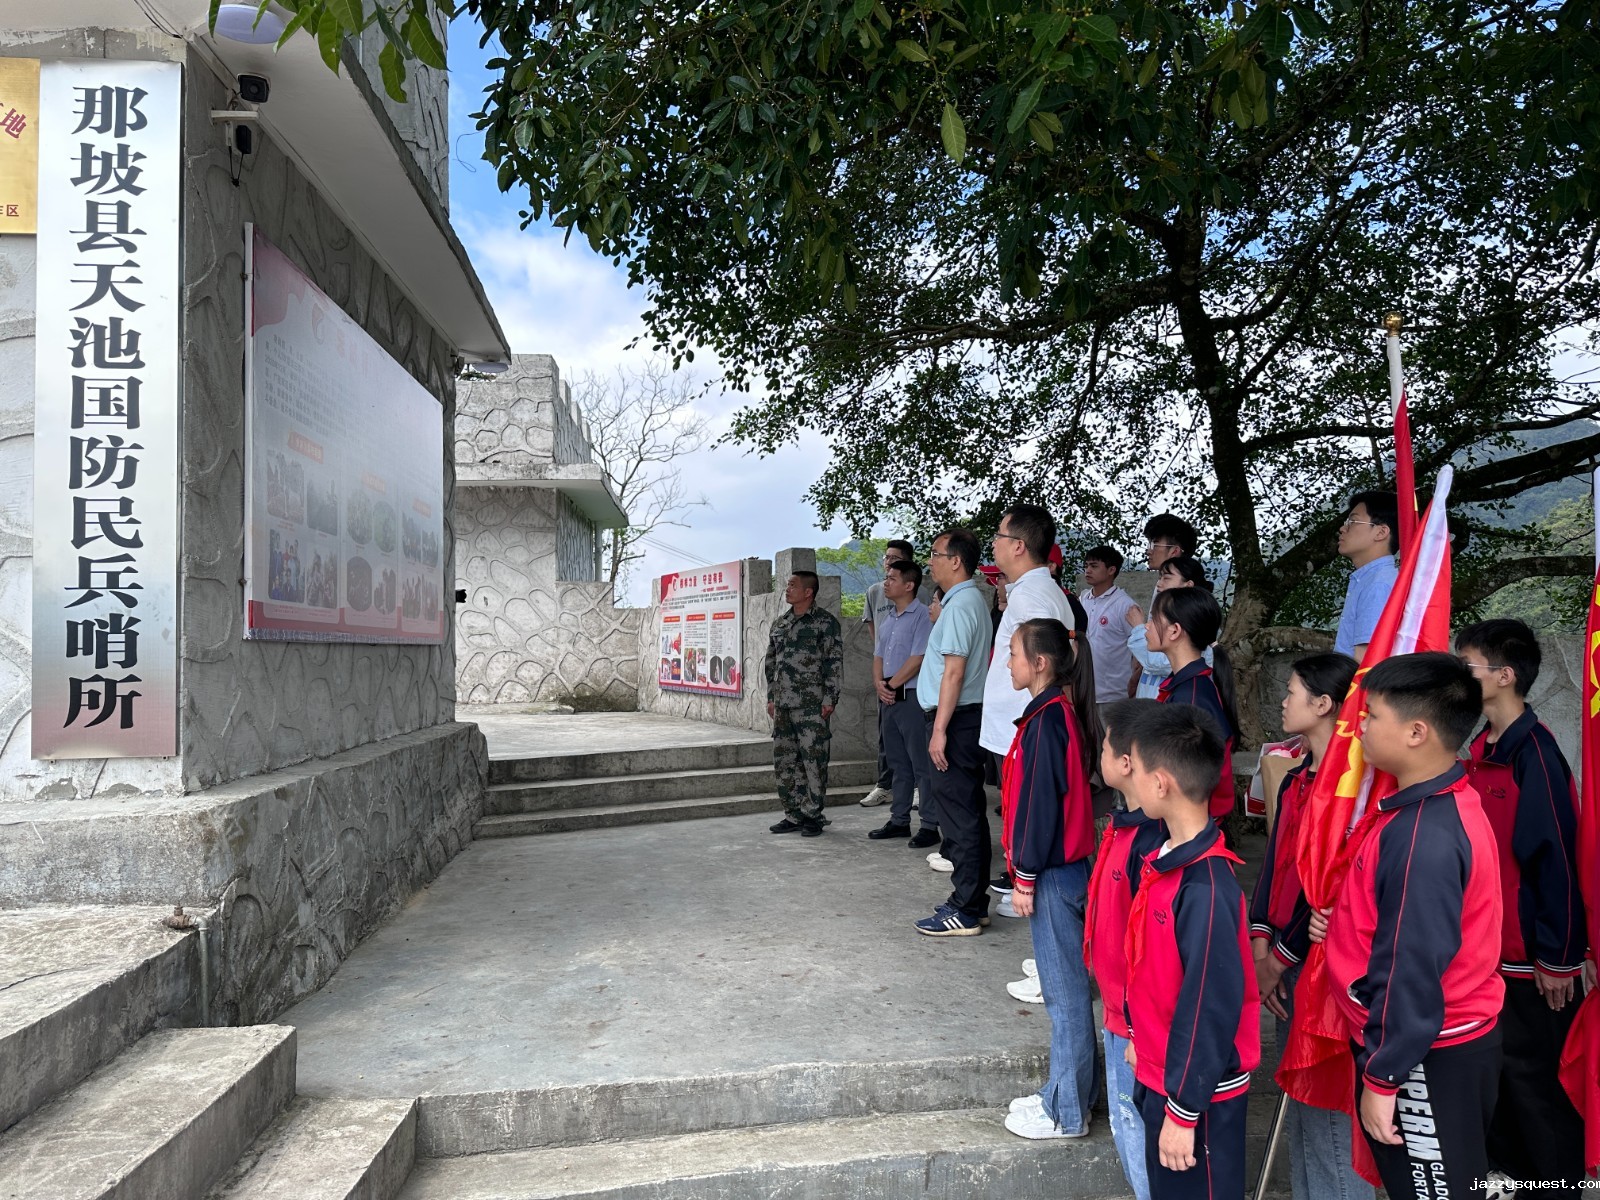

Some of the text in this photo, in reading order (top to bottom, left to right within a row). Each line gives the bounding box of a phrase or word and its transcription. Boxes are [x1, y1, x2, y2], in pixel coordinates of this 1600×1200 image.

[0, 103, 27, 139] 地
[0, 204, 19, 217] 区
[63, 85, 149, 729] 那坡县天池国防民兵哨所
